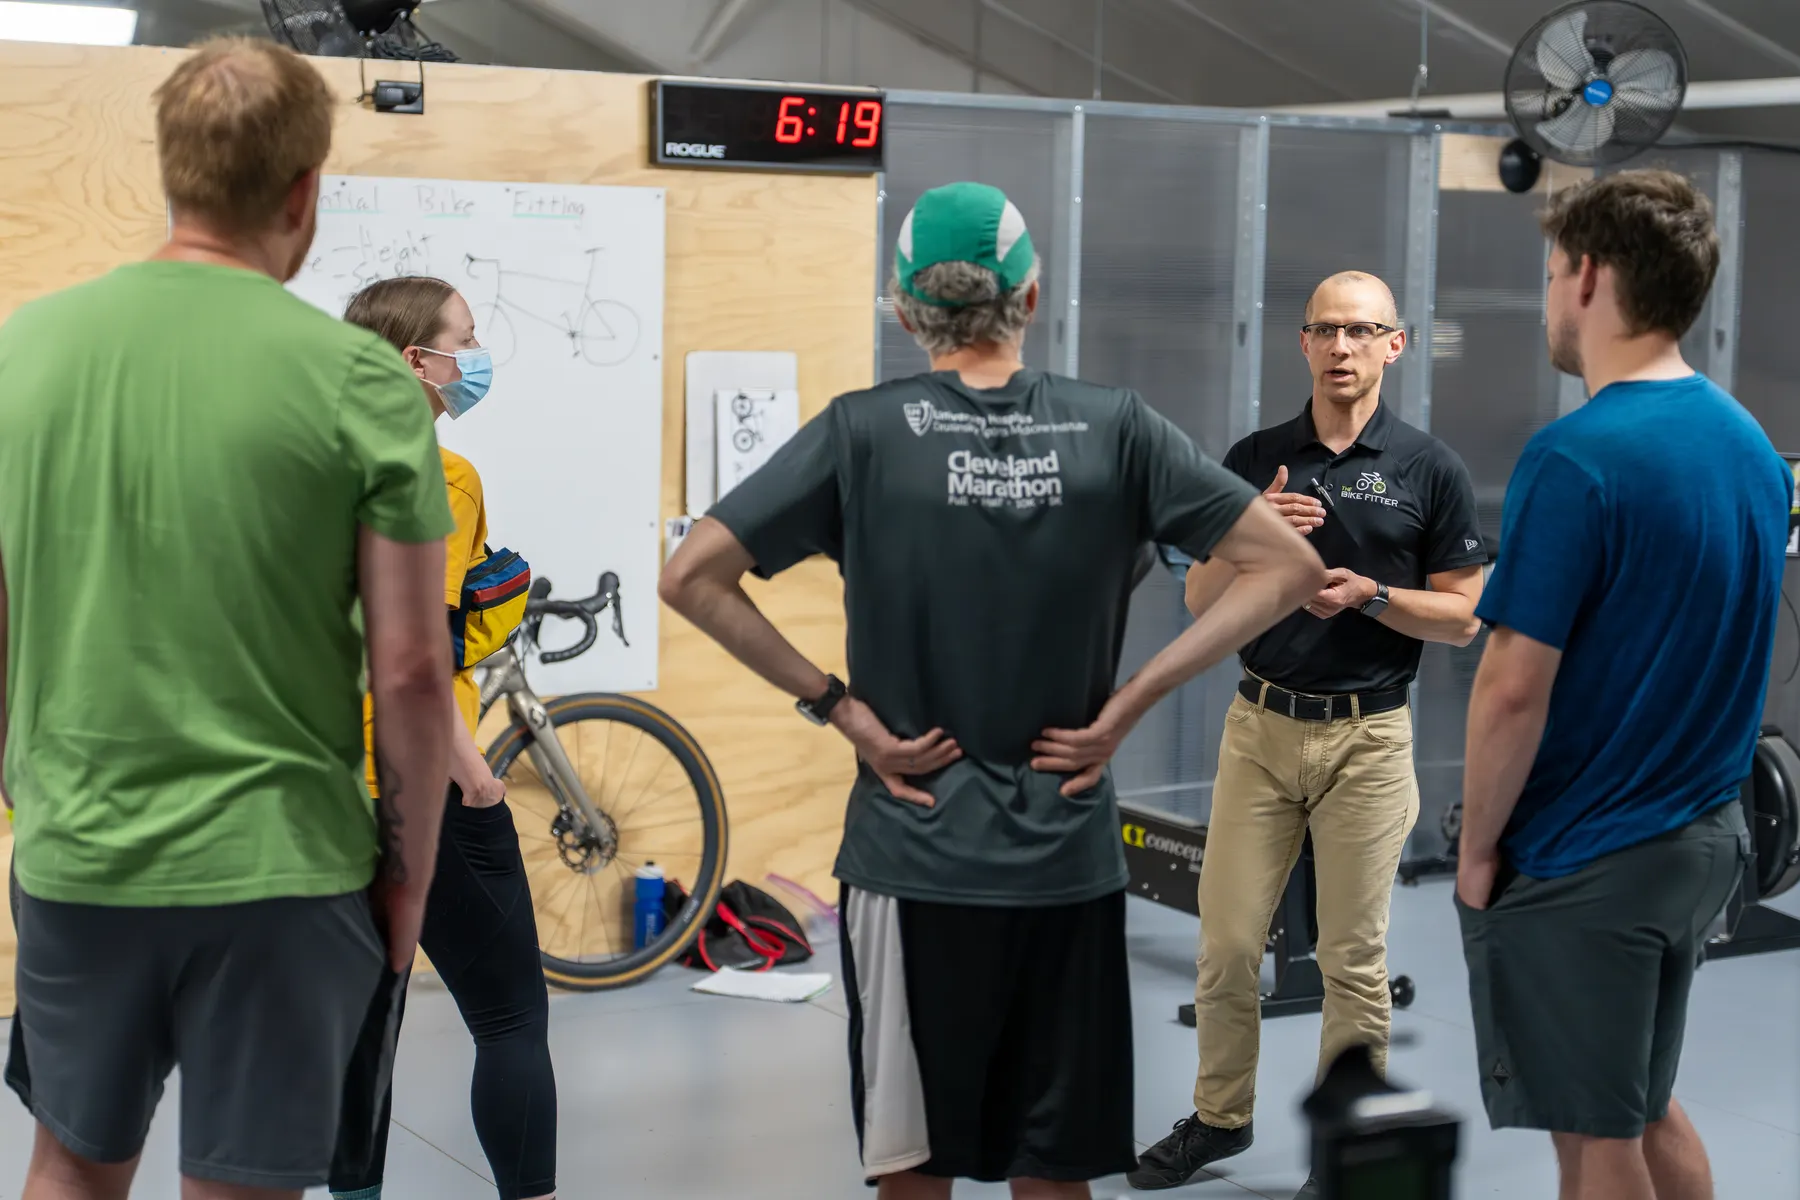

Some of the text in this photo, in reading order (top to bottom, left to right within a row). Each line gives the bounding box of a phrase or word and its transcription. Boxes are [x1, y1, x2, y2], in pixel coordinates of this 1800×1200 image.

[775, 97, 882, 147] 6:19
[665, 142, 727, 158] ROGUE
[414, 185, 476, 212] Bike
[948, 450, 1060, 477] Cleveland
[948, 472, 1062, 499] Marathon
[1341, 491, 1399, 507] BIKE FITTER
[1145, 833, 1204, 862] concep
